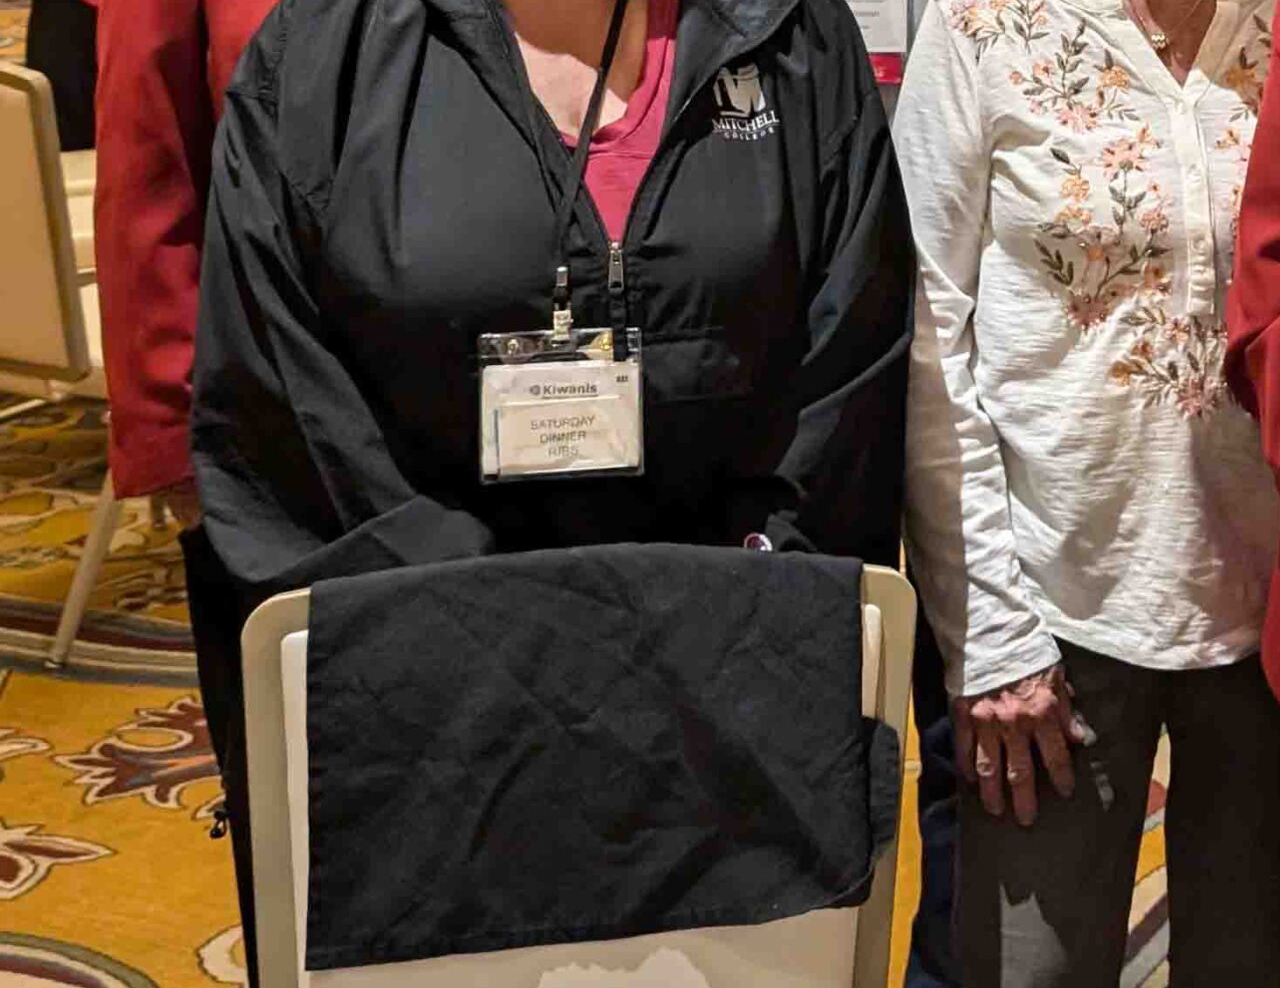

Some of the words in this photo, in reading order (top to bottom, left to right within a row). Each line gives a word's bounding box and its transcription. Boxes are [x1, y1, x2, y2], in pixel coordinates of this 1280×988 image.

[712, 110, 780, 131] MITCHELL
[542, 383, 598, 395] Kiwanis
[530, 415, 596, 430] SATURDAY
[540, 430, 587, 444] DINNER
